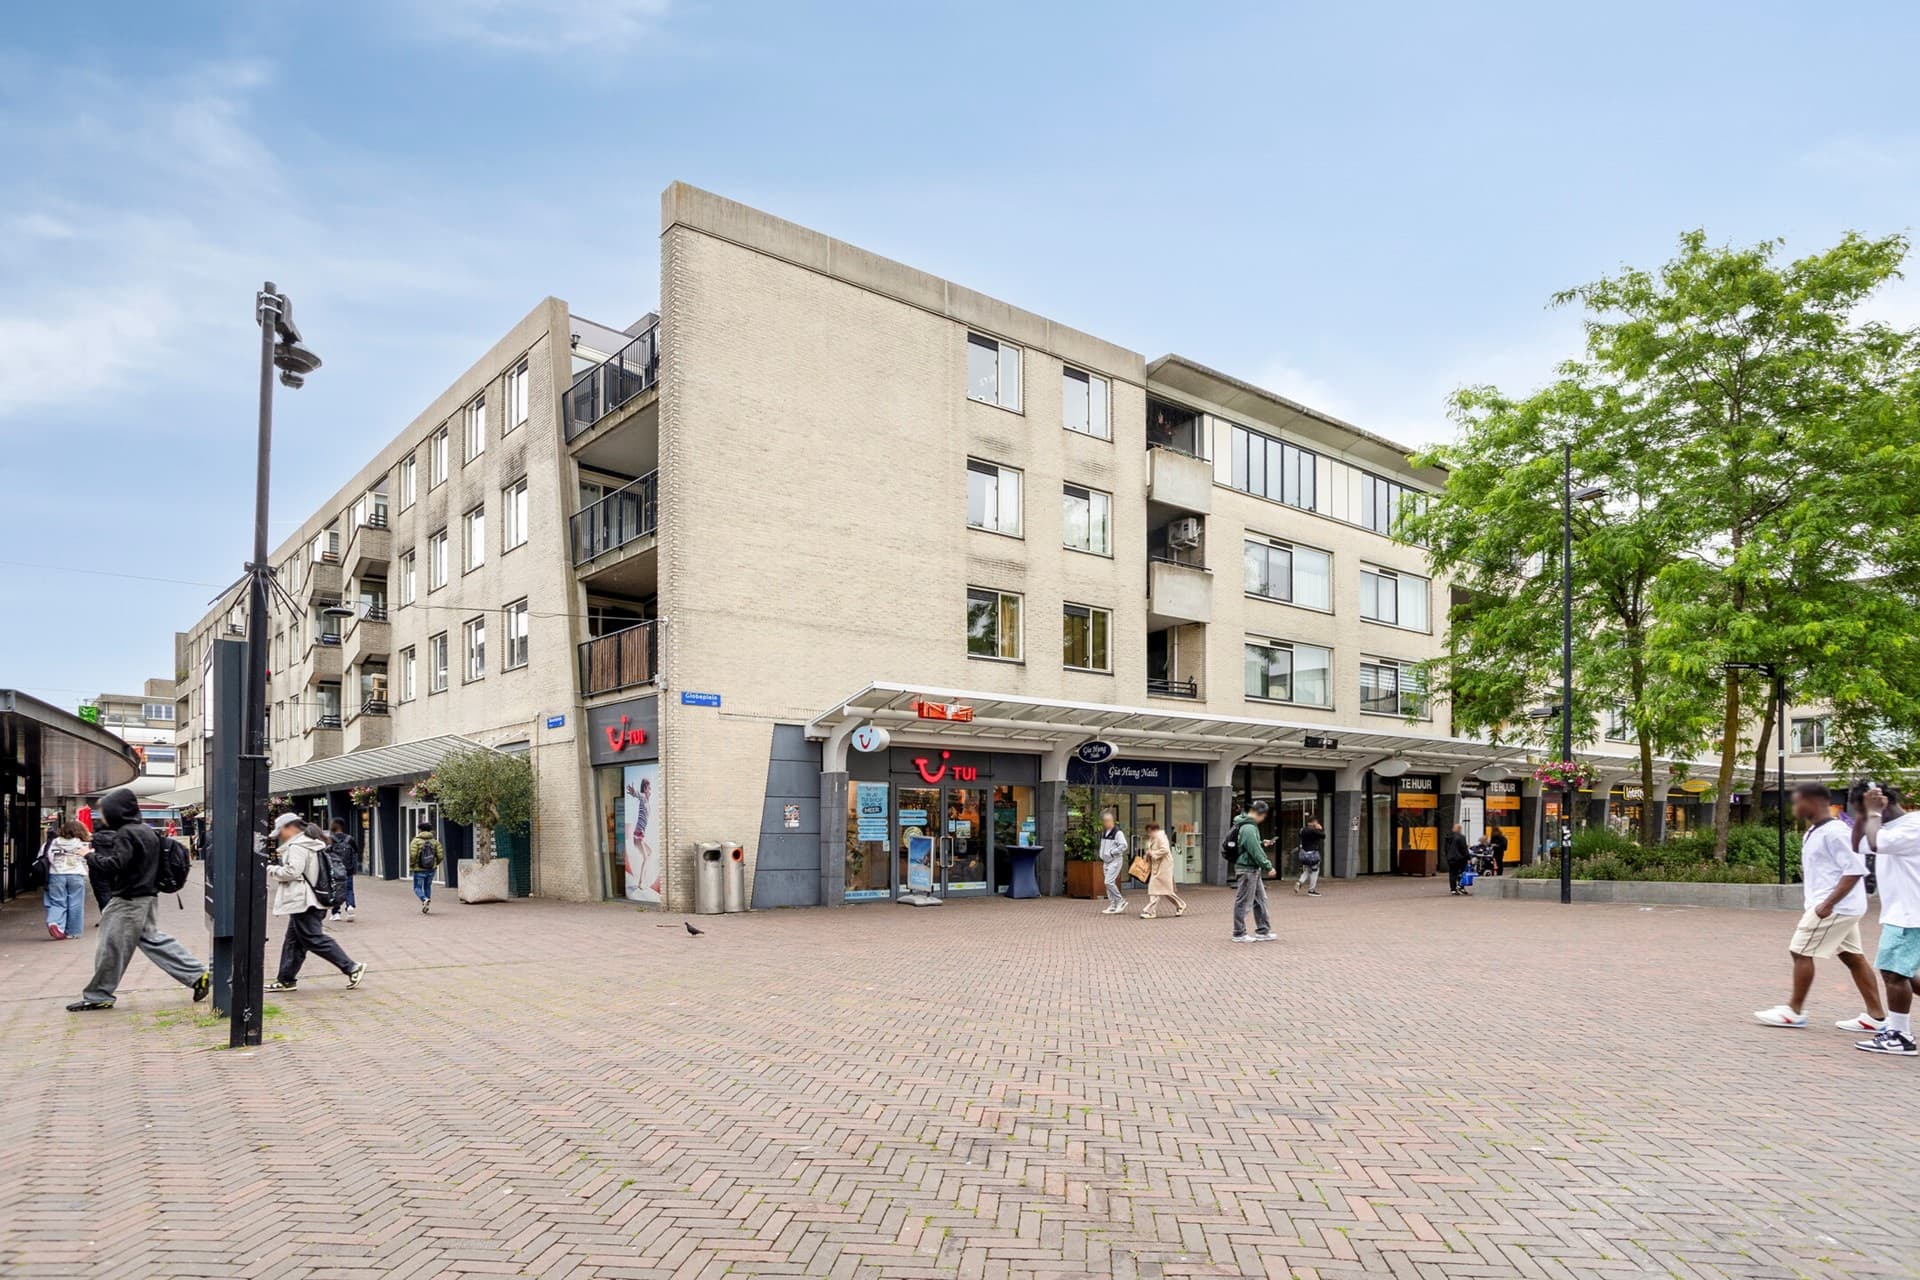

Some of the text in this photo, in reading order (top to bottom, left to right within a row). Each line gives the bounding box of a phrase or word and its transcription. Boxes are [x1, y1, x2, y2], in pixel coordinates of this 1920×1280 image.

[628, 728, 645, 745] TUI
[952, 767, 977, 781] TUI
[1141, 768, 1159, 778] Nails
[1401, 779, 1432, 790] TE HUUR
[1490, 782, 1499, 793] TE
[1499, 782, 1515, 793] HUUR
